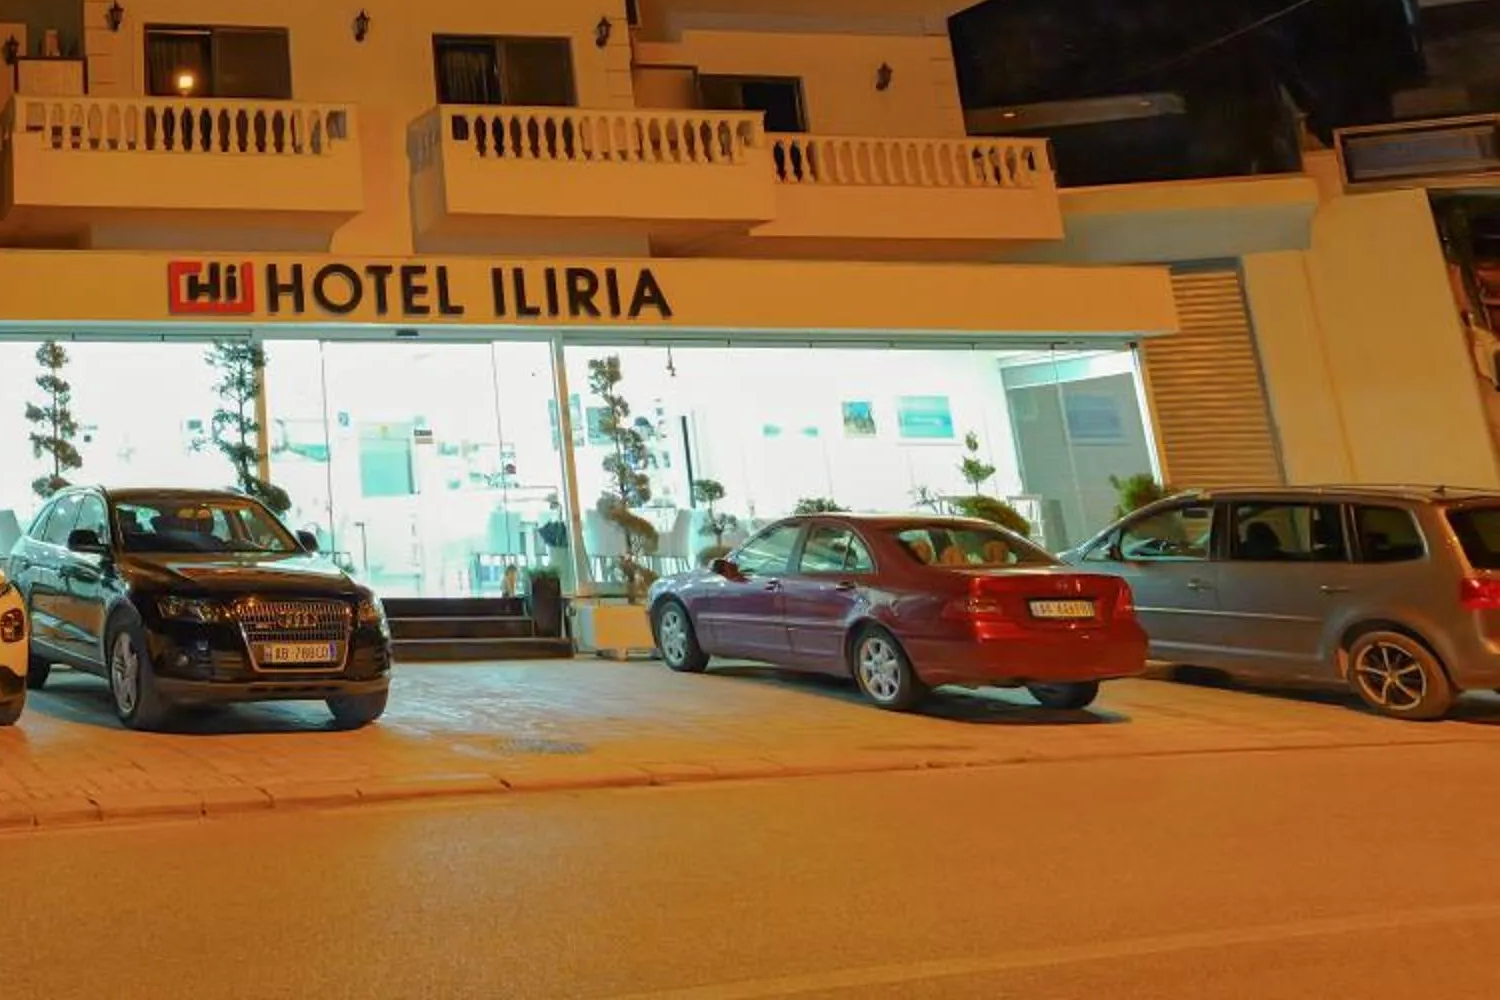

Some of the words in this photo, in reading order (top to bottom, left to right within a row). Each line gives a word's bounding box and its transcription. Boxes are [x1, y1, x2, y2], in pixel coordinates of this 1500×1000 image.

[187, 262, 237, 302] Hi
[266, 263, 465, 316] HOTEL
[490, 267, 673, 318] ILIRIA
